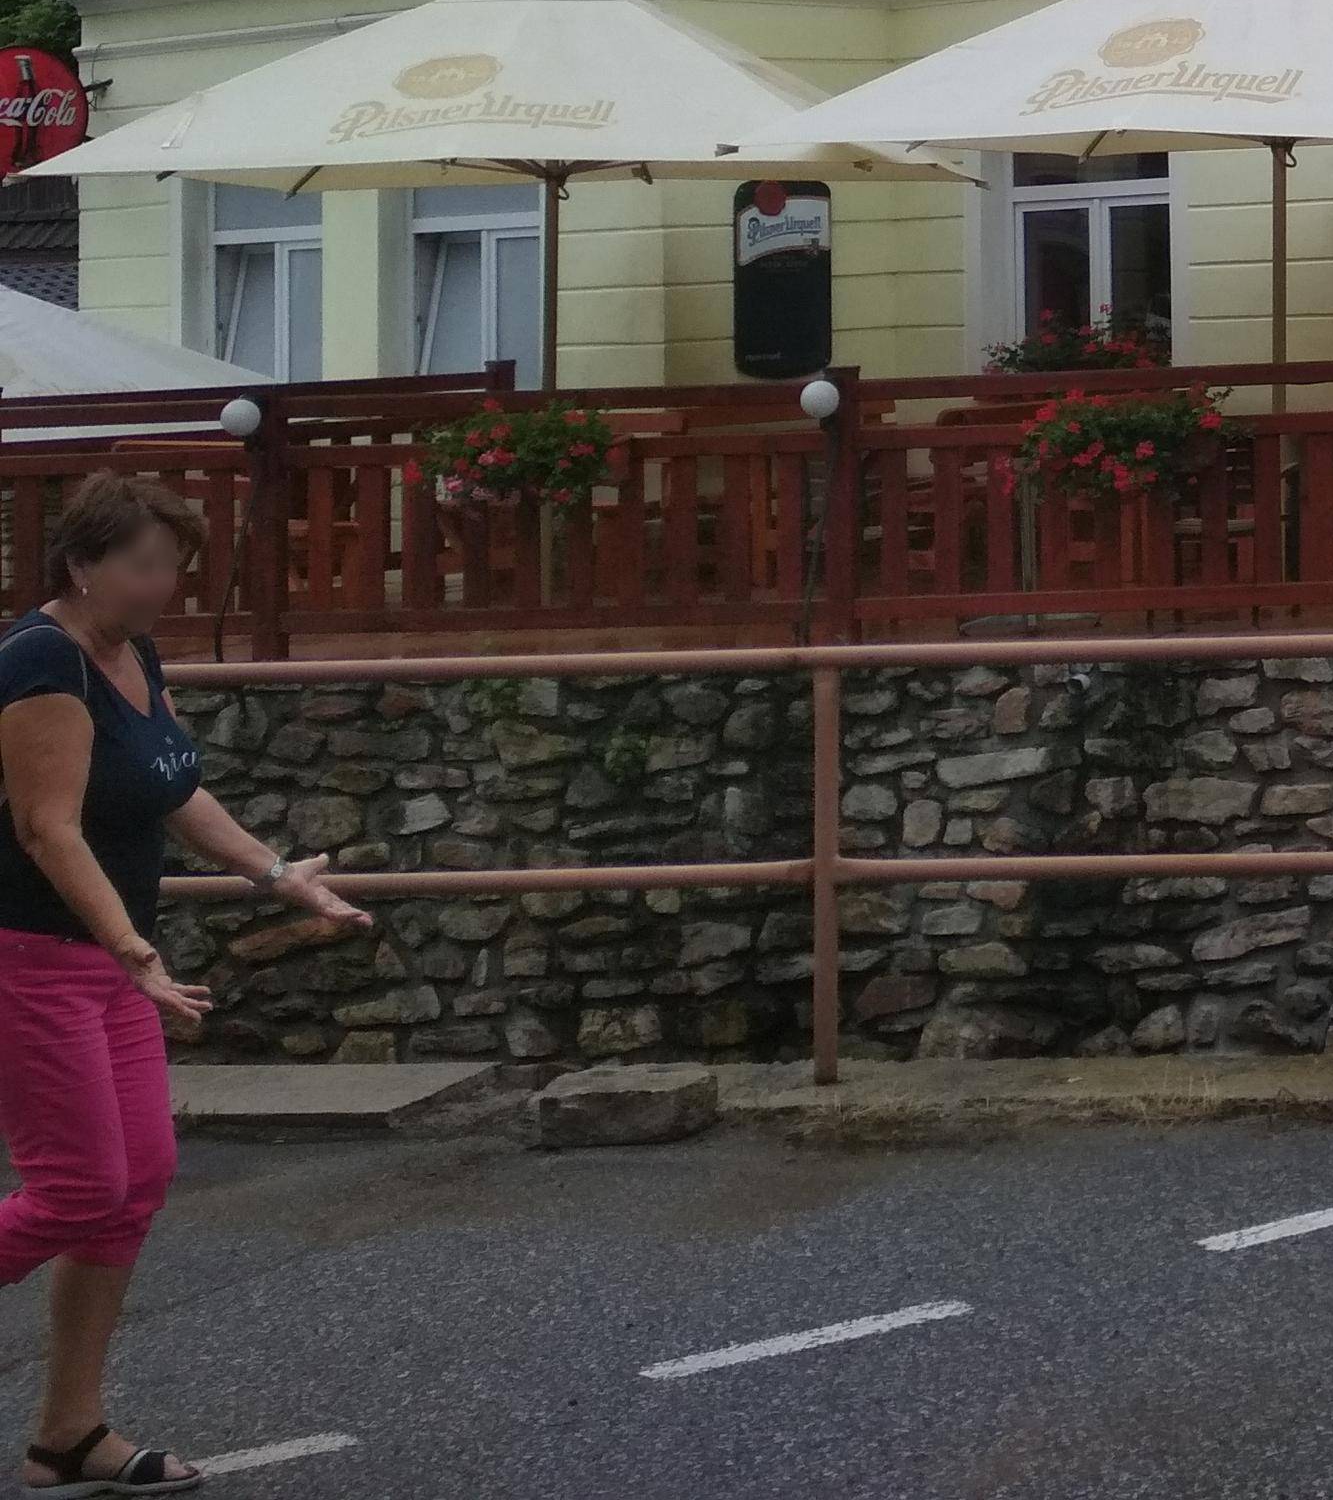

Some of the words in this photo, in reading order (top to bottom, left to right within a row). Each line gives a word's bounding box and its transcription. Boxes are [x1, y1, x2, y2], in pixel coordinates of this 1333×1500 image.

[1017, 68, 1176, 117] Pilsner
[1168, 60, 1304, 103] Urquell
[326, 100, 485, 146] Pilsner
[481, 92, 616, 129] Urquell
[746, 216, 786, 248] Pilsner
[784, 215, 822, 237] Urquell
